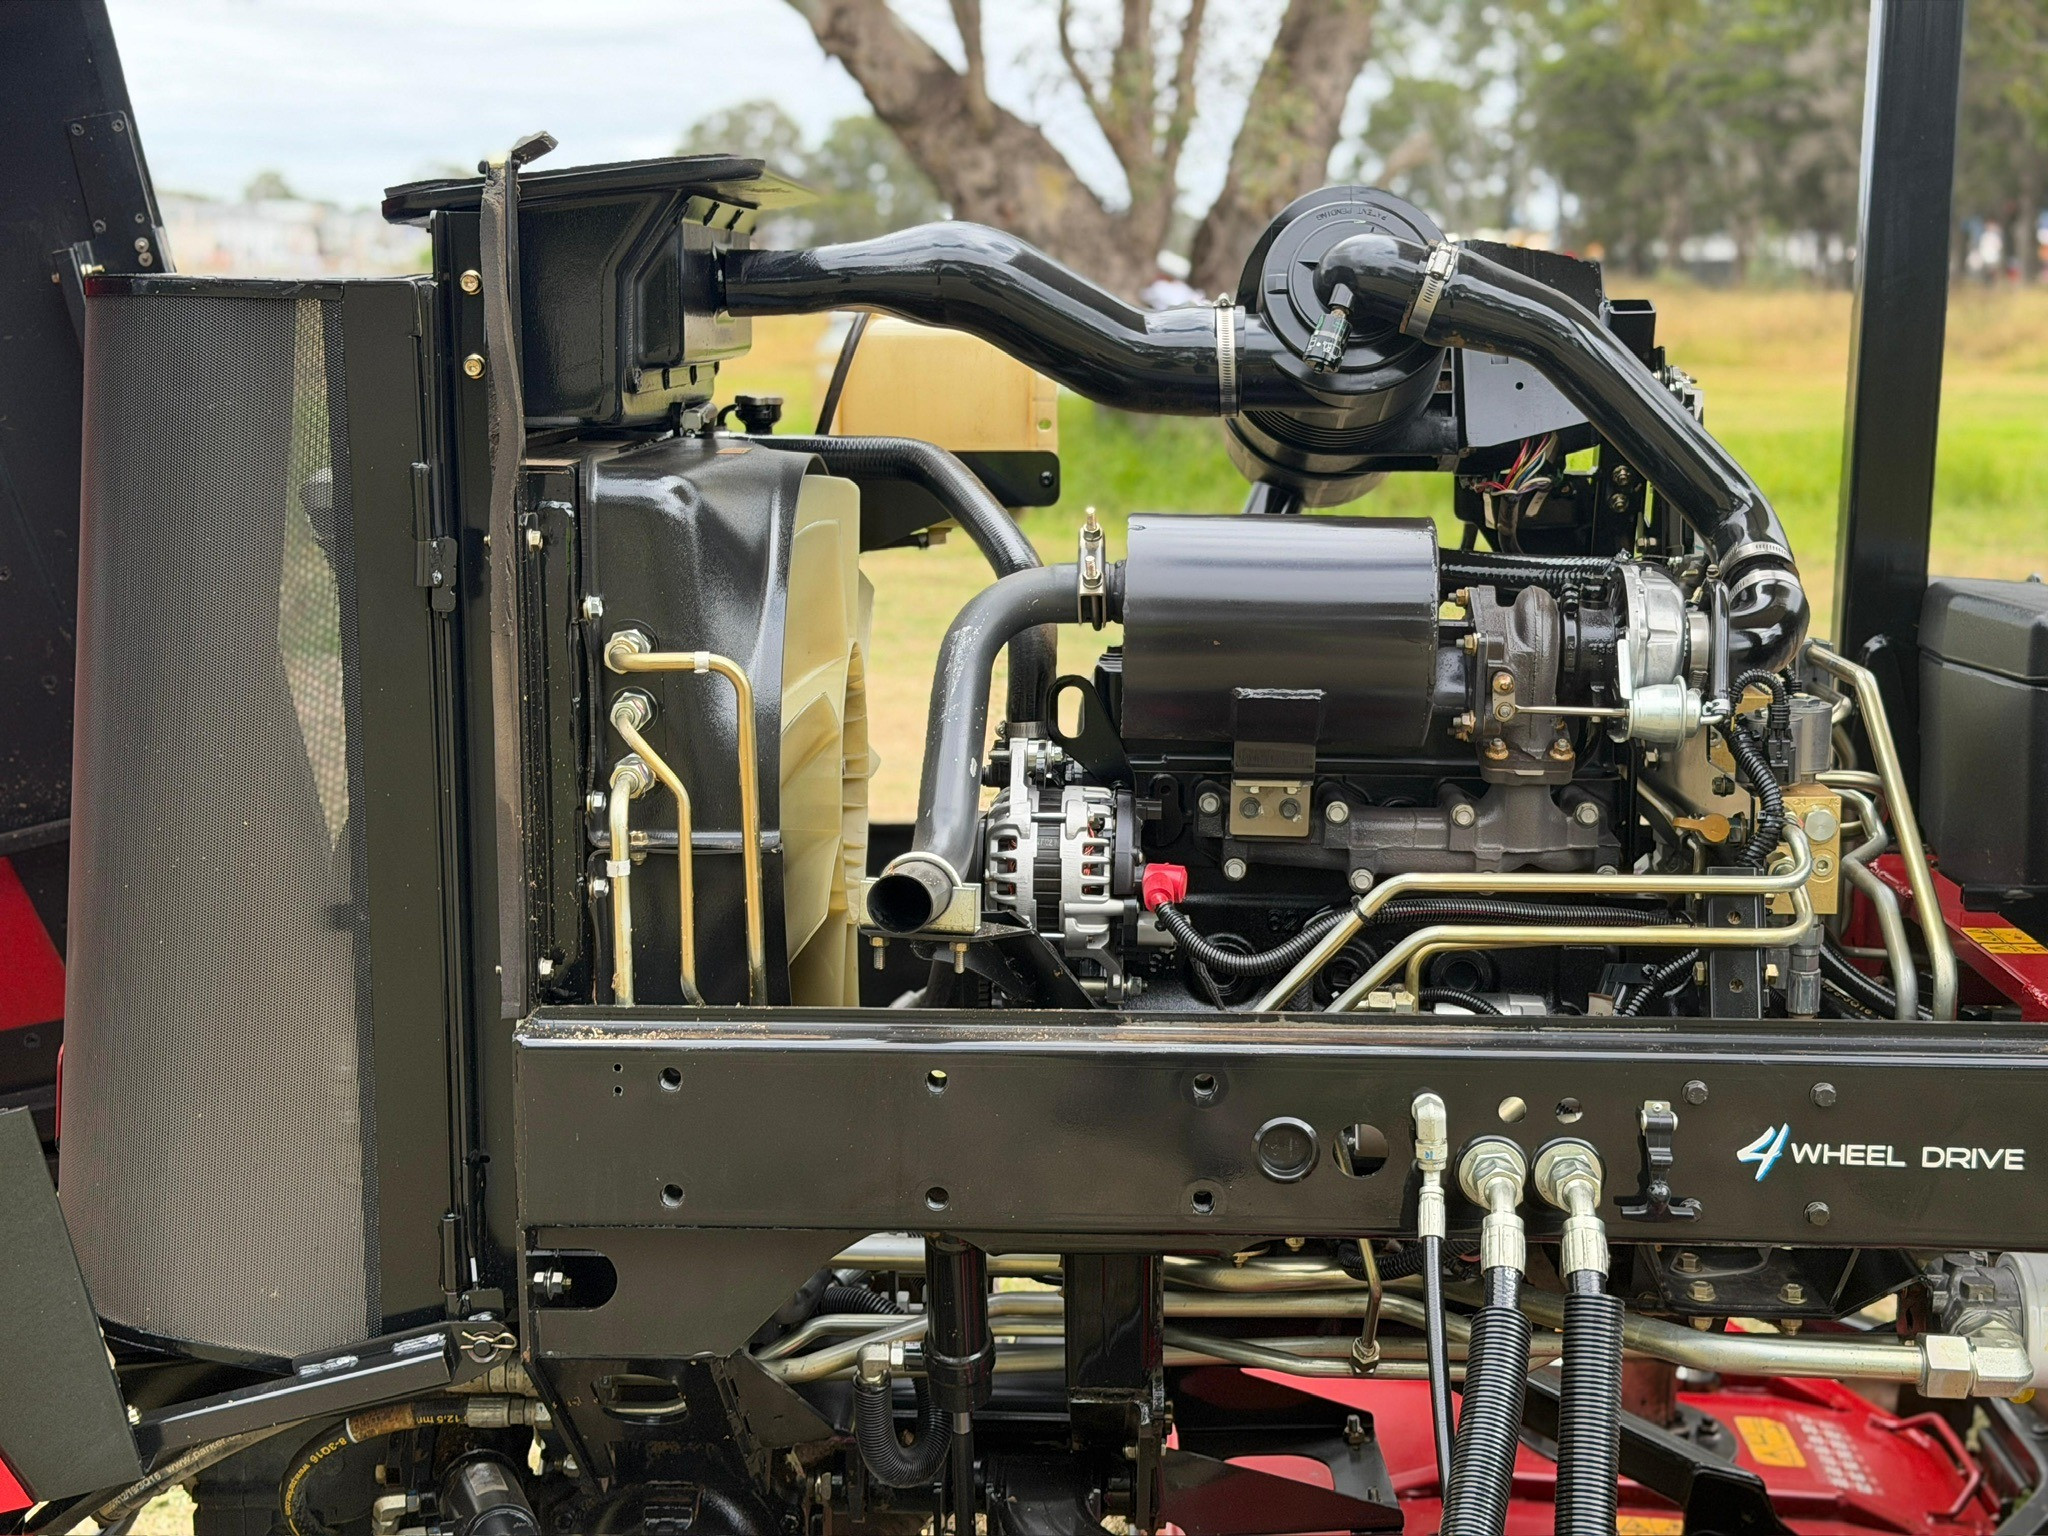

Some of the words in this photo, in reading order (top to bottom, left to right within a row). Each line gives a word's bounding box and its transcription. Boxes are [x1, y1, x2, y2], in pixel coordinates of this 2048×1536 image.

[1315, 207, 1353, 221] PENDING
[1736, 1122, 1790, 1181] 4
[1790, 1142, 1907, 1168] WHEEL
[1921, 1146, 2026, 1171] DRIVE
